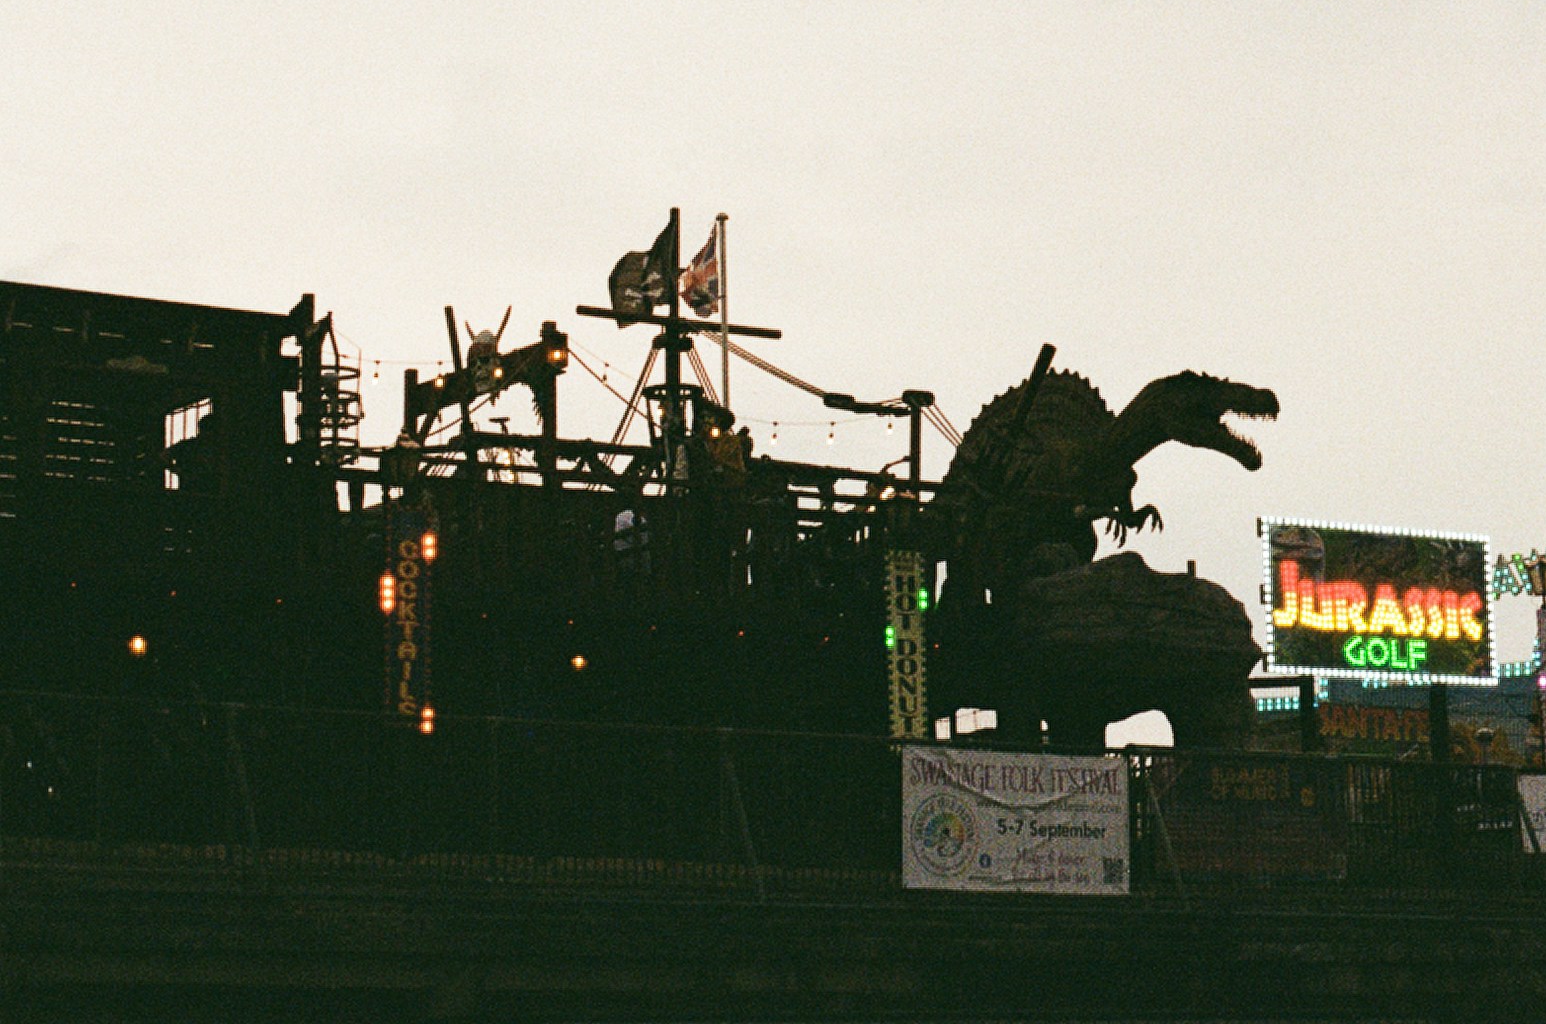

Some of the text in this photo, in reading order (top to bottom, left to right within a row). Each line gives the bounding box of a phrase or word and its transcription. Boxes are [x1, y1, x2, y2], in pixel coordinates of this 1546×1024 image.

[896, 575, 917, 630] HOT
[1272, 559, 1483, 641] JURASSIC
[397, 539, 420, 716] COCKTAILS
[1343, 635, 1428, 670] GOLF
[1001, 765, 1046, 794] FOLK
[996, 817, 1106, 840] 5-7 September
